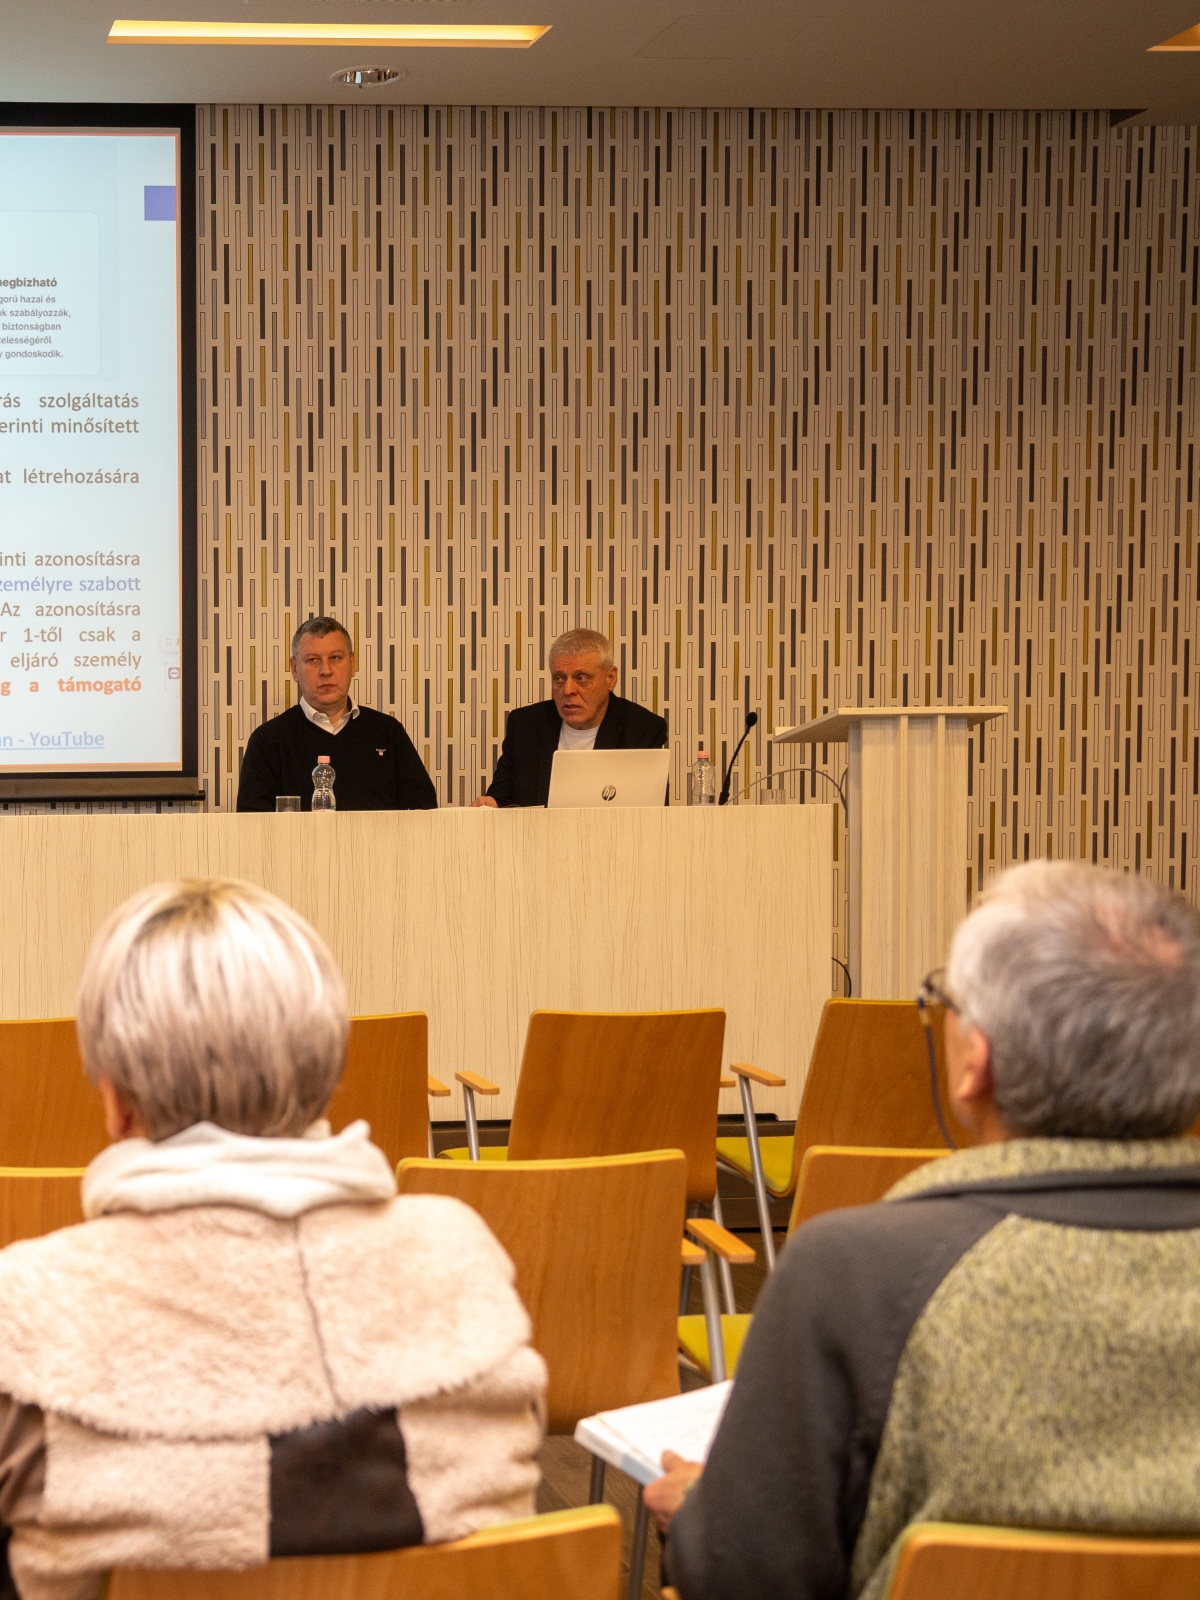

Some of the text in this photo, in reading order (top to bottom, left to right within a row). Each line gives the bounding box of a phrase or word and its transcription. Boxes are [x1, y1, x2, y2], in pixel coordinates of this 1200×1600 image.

[9, 309, 71, 318] szabályozzák,
[1, 323, 62, 332] biztonságban
[4, 350, 64, 359] gondoskodik.
[39, 393, 139, 411] szolgáltatás
[34, 552, 140, 566] azonosításra
[79, 576, 141, 591] szabott
[23, 627, 62, 642] 1-től
[78, 627, 116, 641] csak
[131, 630, 141, 641] a
[28, 681, 40, 692] a
[56, 677, 143, 695] támogató
[29, 731, 105, 747] YouTube
[602, 785, 617, 801] hp
